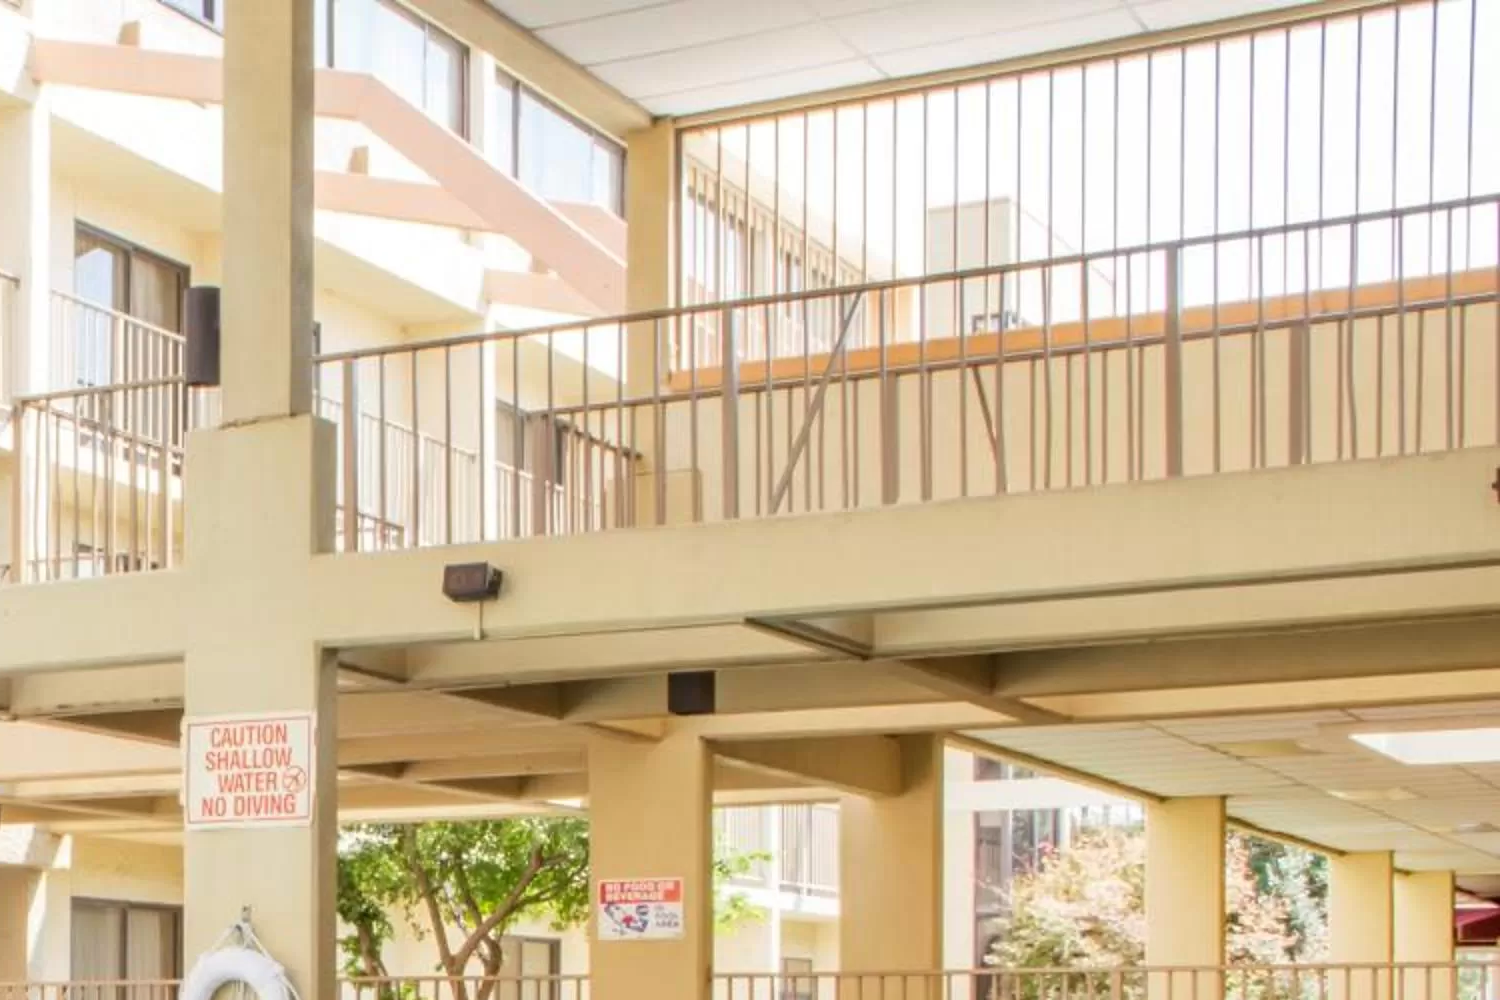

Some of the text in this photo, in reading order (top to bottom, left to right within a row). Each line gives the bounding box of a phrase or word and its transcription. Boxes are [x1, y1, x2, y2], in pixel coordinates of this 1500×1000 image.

[210, 723, 288, 748] CAUTION
[205, 747, 293, 772] SHALLOW
[217, 771, 278, 793] WATER
[201, 793, 297, 817] NO DIVING
